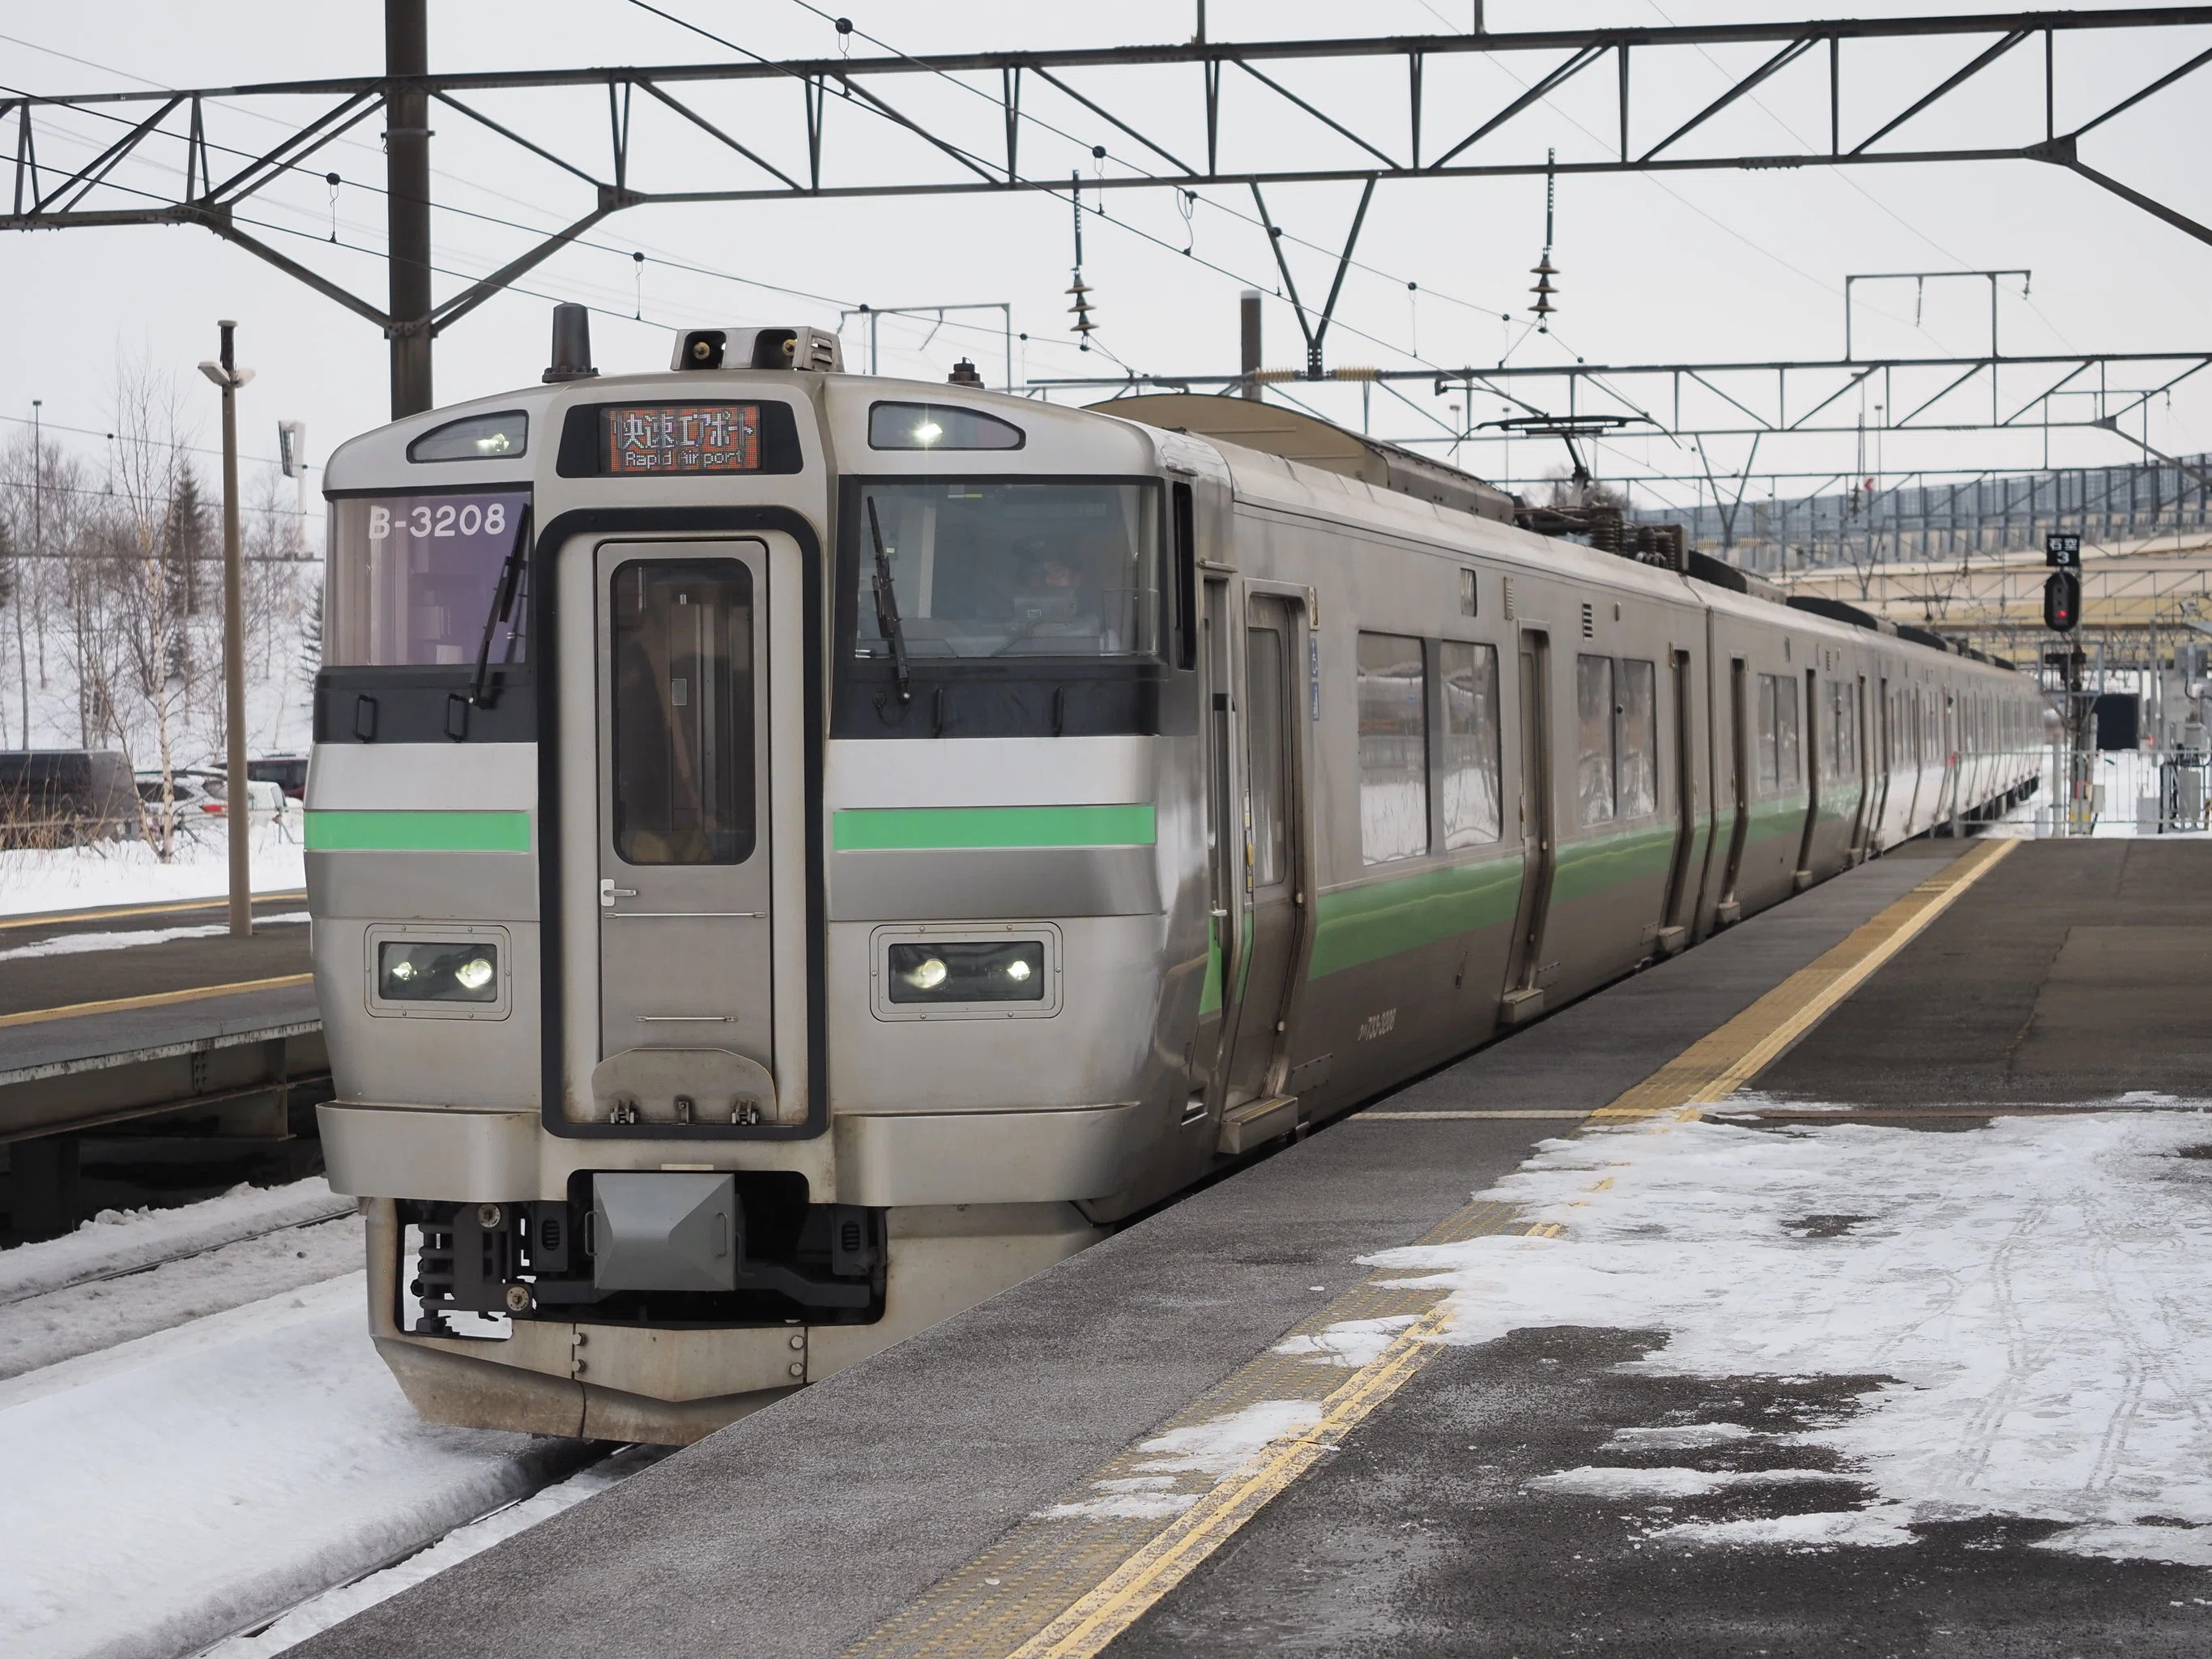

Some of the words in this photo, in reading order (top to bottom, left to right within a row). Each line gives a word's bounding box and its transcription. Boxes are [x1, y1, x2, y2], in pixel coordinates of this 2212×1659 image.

[615, 411, 754, 449] 快速エアポート
[625, 450, 672, 469] Rapid
[680, 450, 743, 467] Airport
[369, 503, 505, 539] B-3208
[2056, 551, 2070, 565] 3
